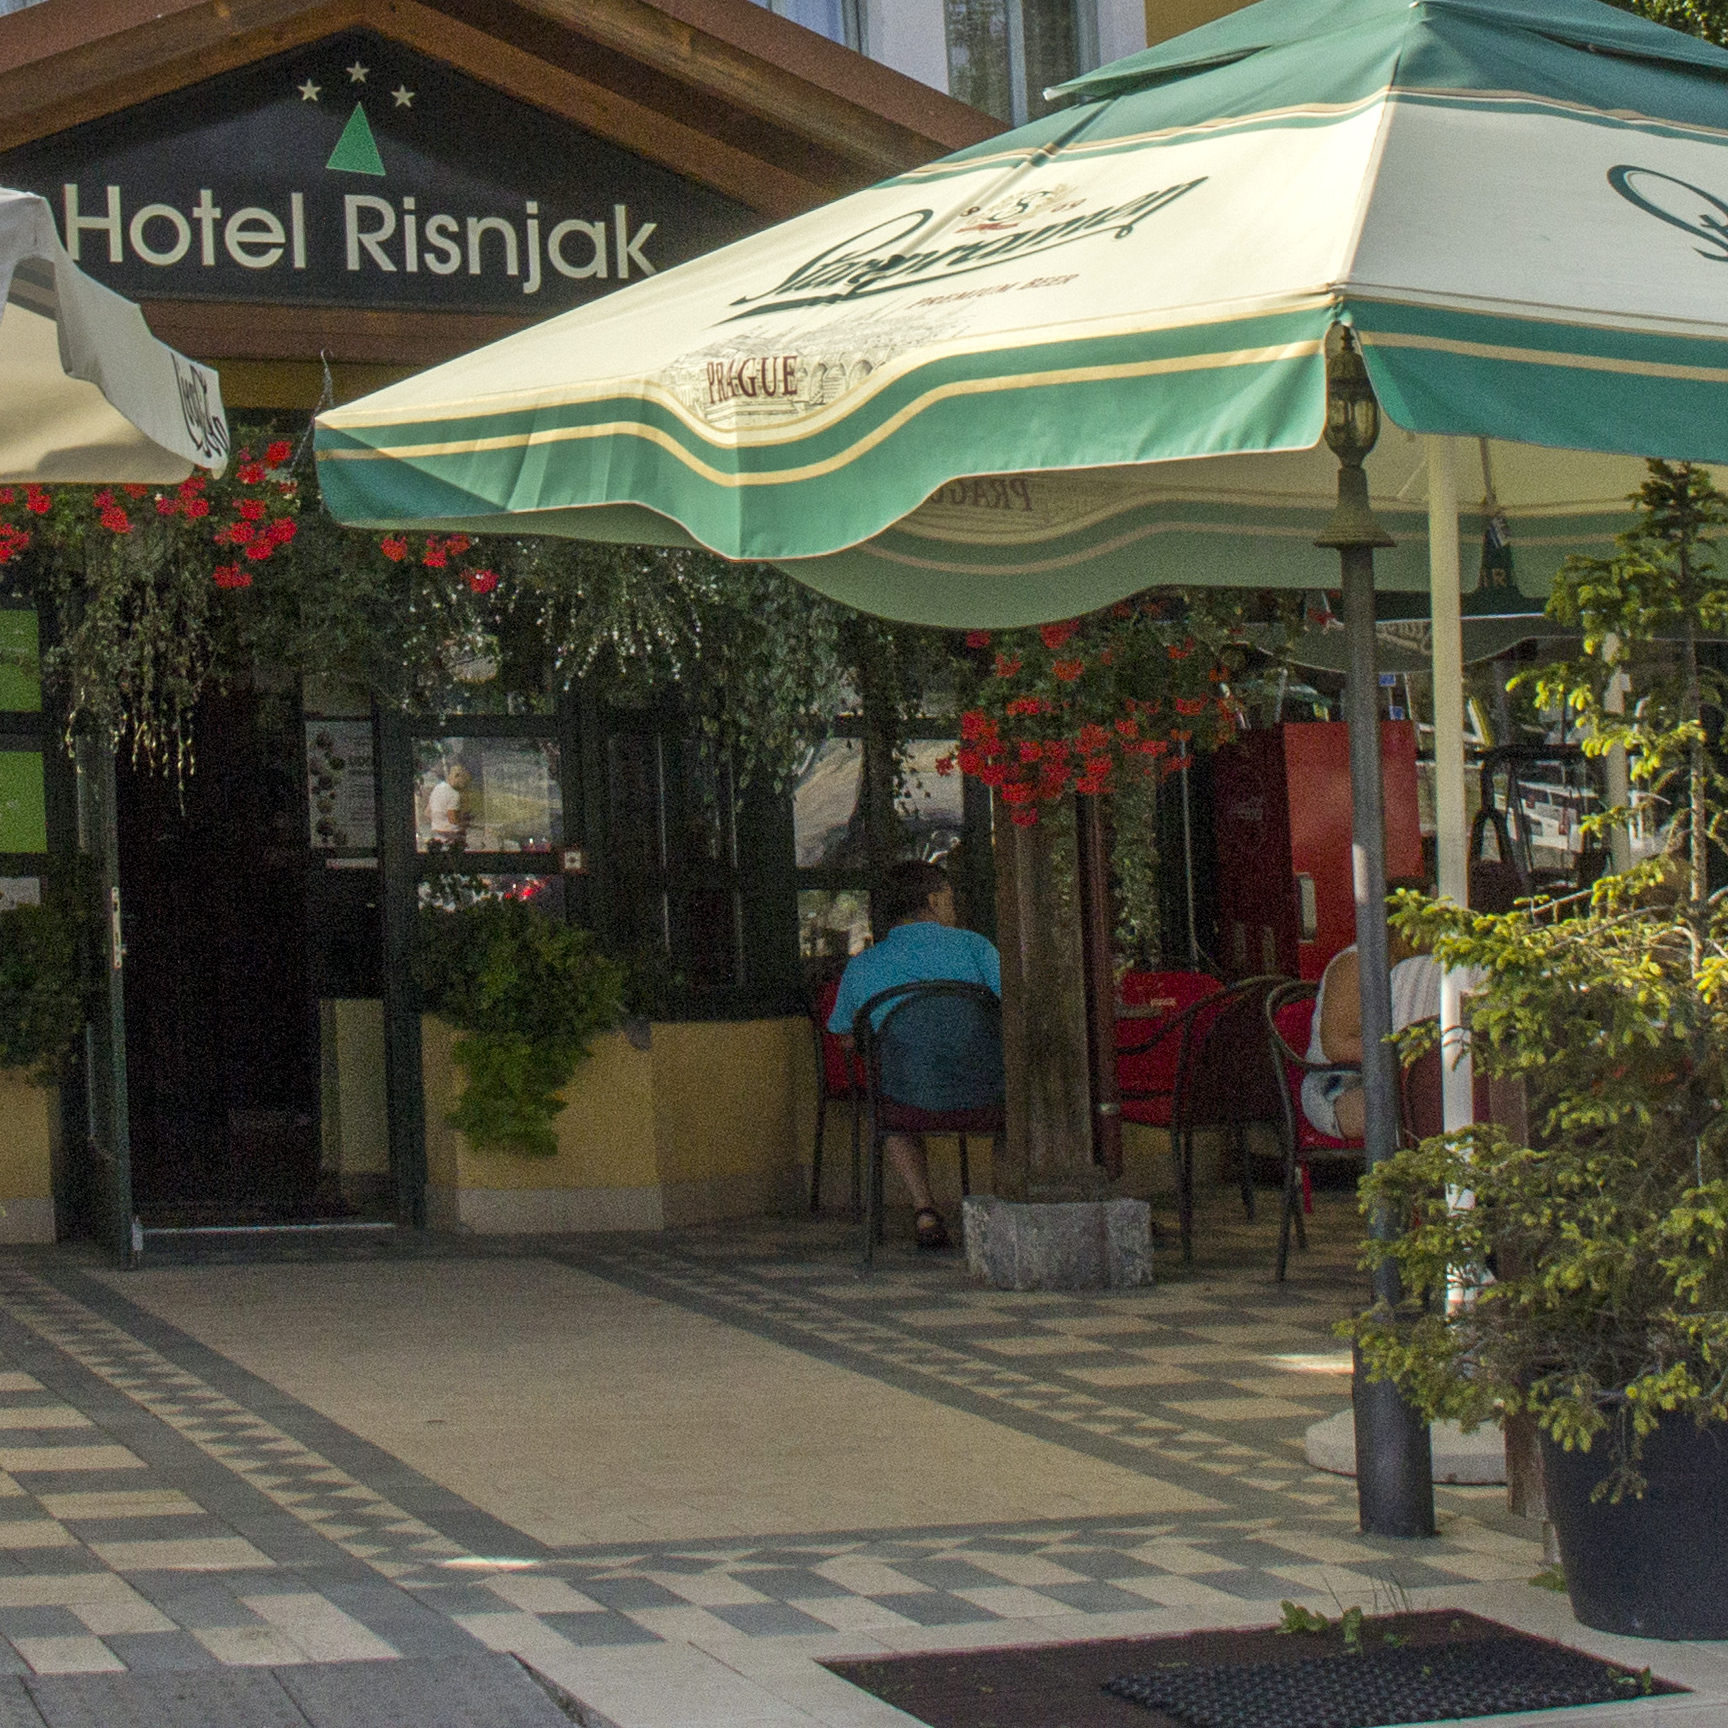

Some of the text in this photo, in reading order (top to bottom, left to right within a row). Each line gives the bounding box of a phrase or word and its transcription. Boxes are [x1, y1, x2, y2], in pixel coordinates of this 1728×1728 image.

[64, 183, 658, 295] Hotel Risnjak
[705, 354, 799, 405] PRAGUE
